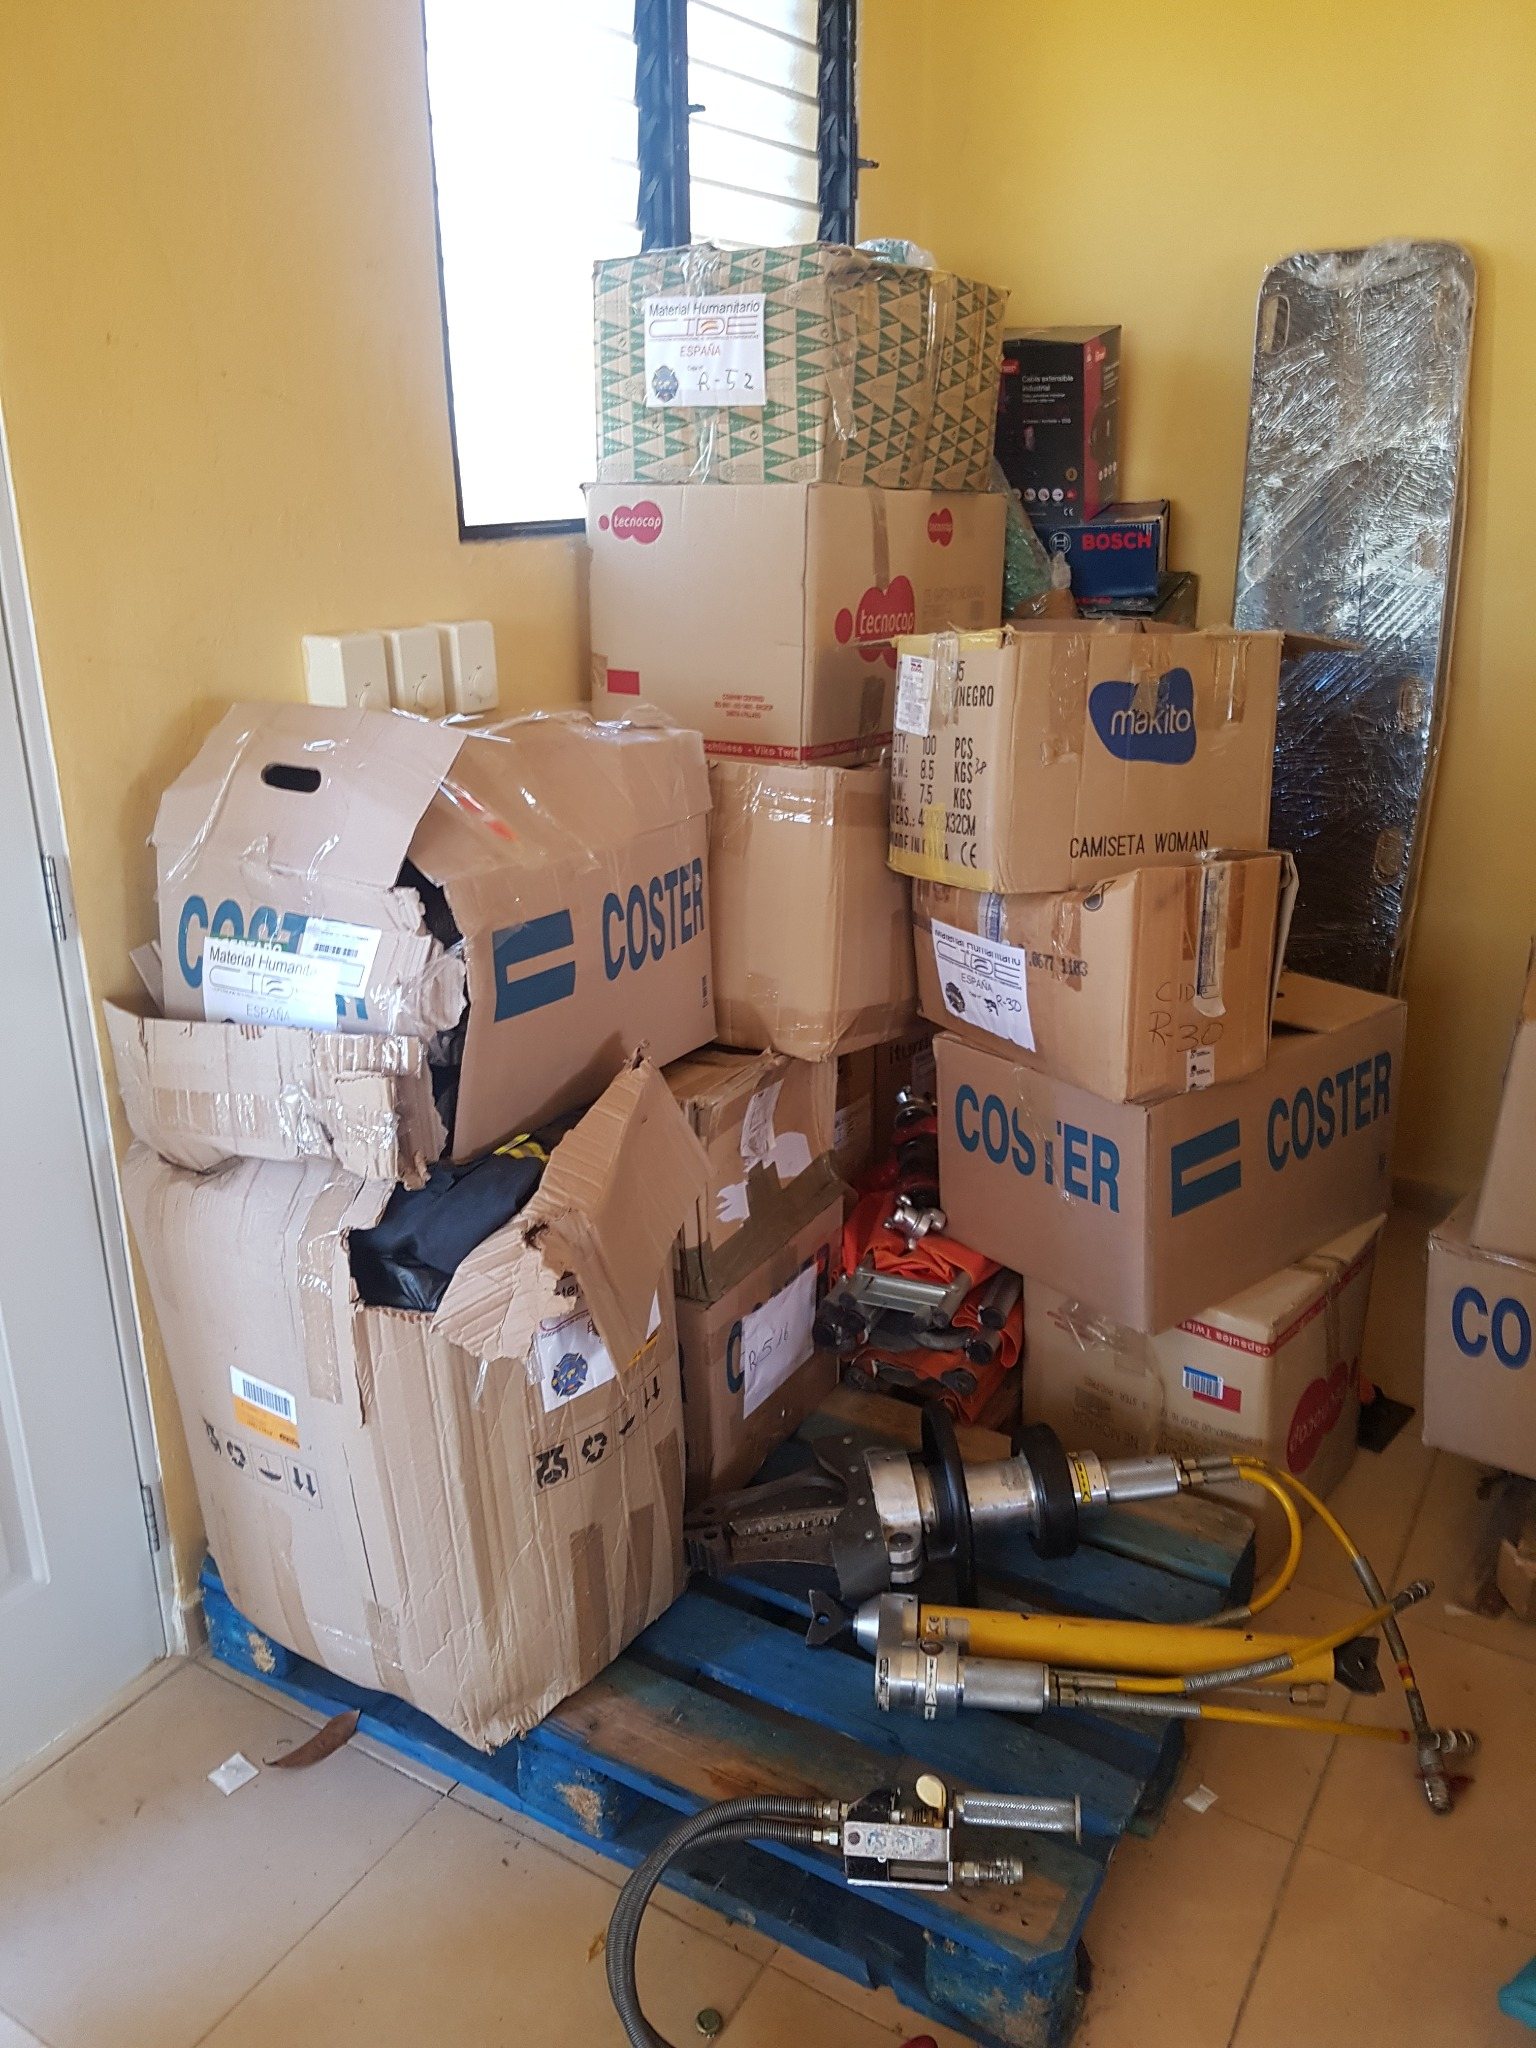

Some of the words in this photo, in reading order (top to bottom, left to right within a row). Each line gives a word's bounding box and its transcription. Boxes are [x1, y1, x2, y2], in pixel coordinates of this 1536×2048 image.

[649, 302, 690, 316] Material
[693, 301, 760, 315] Humanitario
[680, 342, 721, 357] ESPAÑA
[1082, 532, 1152, 550] BOSCH
[1111, 703, 1192, 736] makito
[922, 735, 936, 756] 100
[955, 737, 973, 759] PCS
[920, 759, 934, 780] 8.5
[954, 762, 973, 783] KGS
[920, 784, 933, 804] 7.5
[953, 788, 972, 810] KGS
[1070, 834, 1145, 859] CAMISETA
[1155, 830, 1209, 853] WOMAN
[602, 857, 704, 981] COSTER
[209, 946, 255, 967] Material
[961, 973, 994, 993] ESPAÑA
[246, 1003, 291, 1022] ESPAÑA
[1148, 1011, 1224, 1053] R-30
[1267, 1051, 1391, 1172] COSTER
